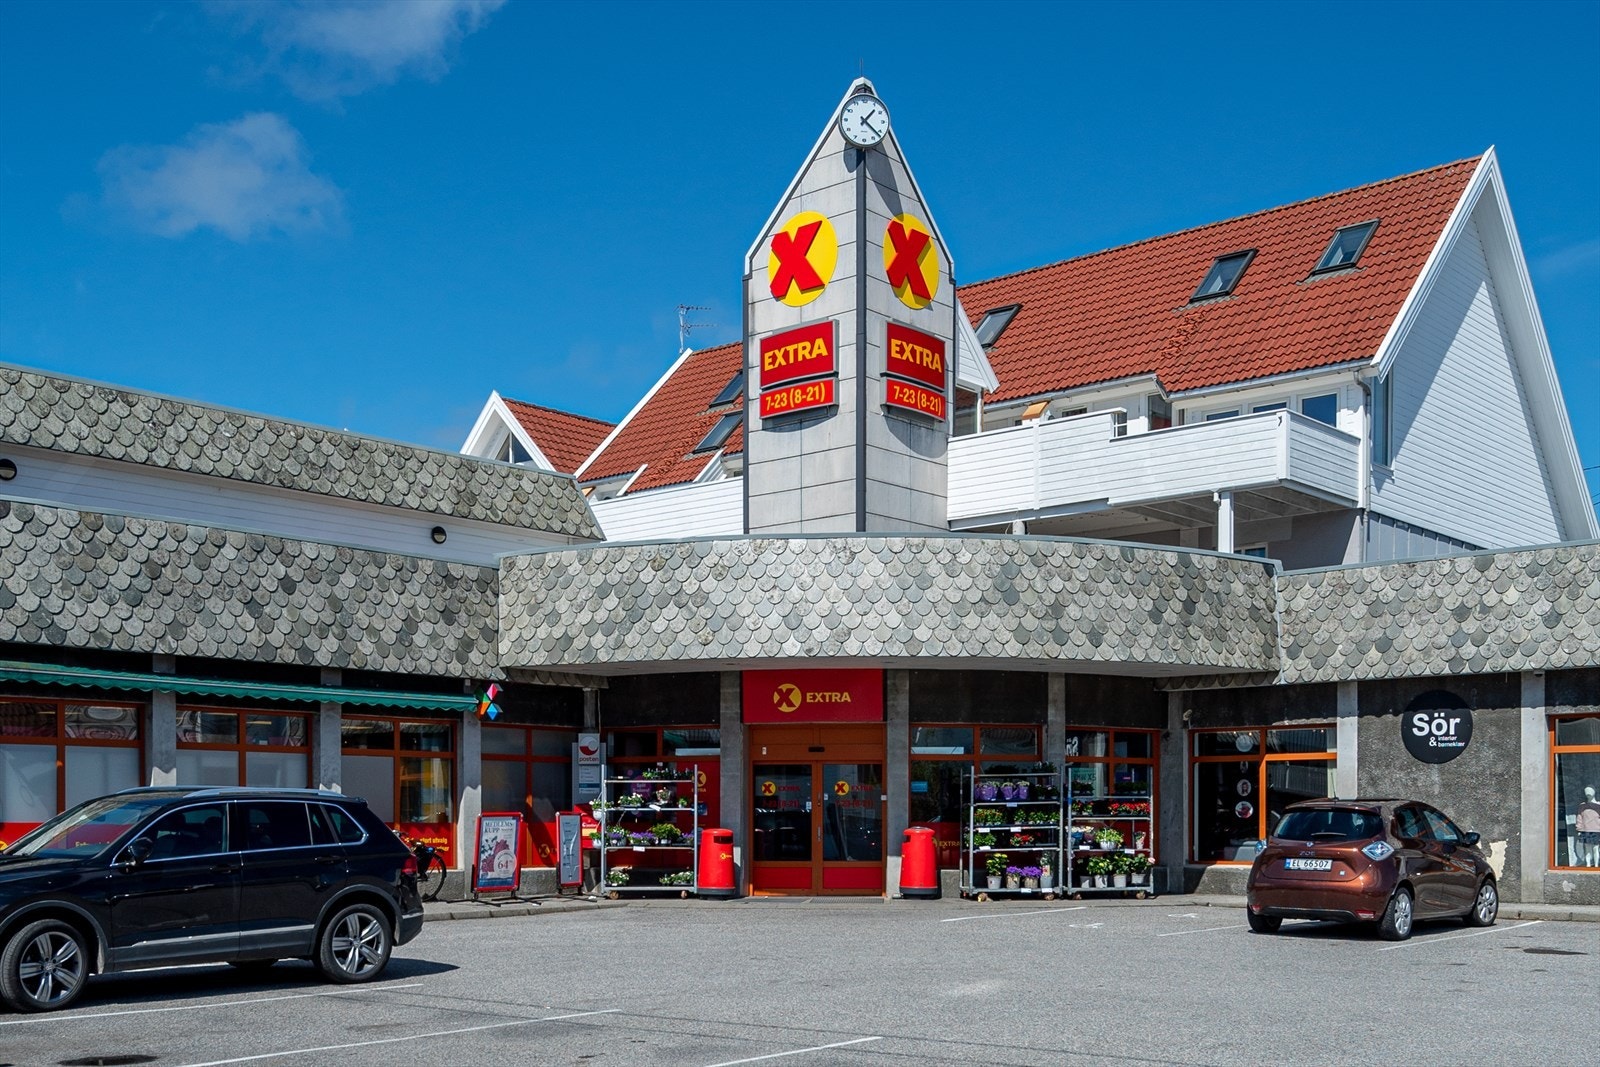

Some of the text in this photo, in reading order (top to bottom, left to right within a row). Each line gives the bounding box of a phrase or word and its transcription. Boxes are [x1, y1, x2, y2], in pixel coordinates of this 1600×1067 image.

[770, 220, 826, 300] X
[886, 219, 932, 301] X
[764, 337, 828, 371] EXTRA
[890, 338, 942, 373] EXTRA
[766, 382, 825, 411] 7-23 (8-21)
[893, 385, 942, 416] 7-23 (8-21)
[806, 692, 852, 703] EXTRA
[1412, 712, 1461, 737] Sör
[1428, 736, 1437, 747] &
[1303, 860, 1329, 868] 66507
